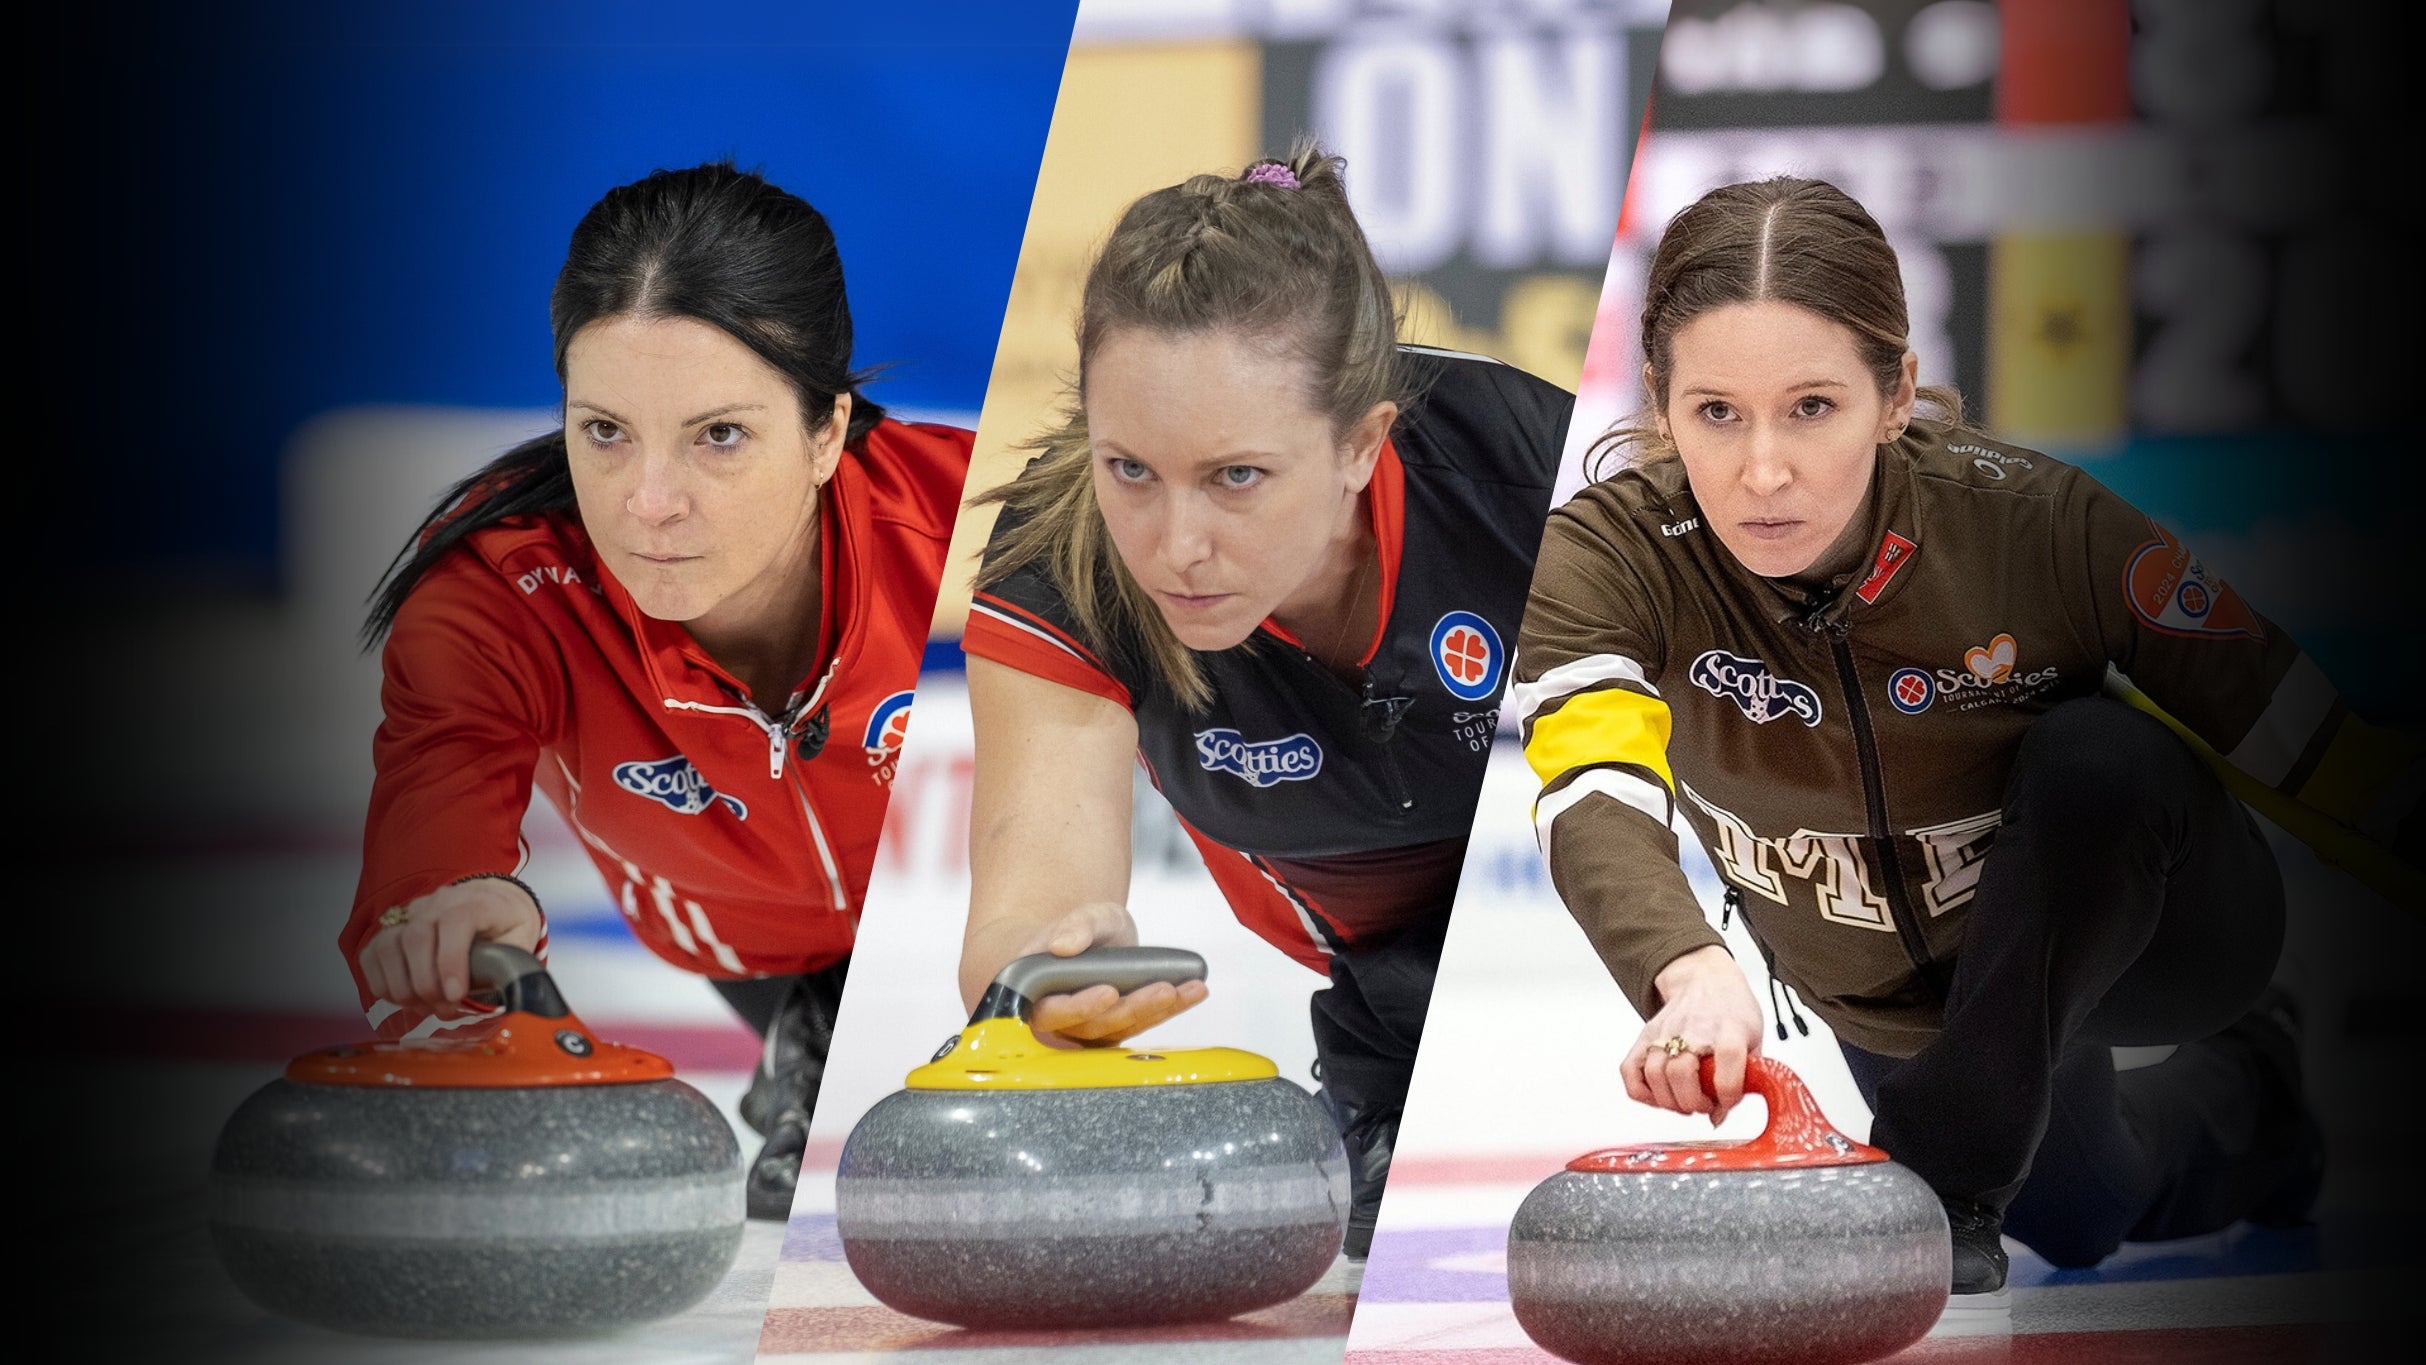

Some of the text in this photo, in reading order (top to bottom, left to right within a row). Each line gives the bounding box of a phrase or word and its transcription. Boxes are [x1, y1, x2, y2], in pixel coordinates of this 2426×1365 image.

[1936, 667, 2058, 694] Scoies
[1195, 732, 1315, 774] Scotties
[1469, 735, 1490, 753] OF
